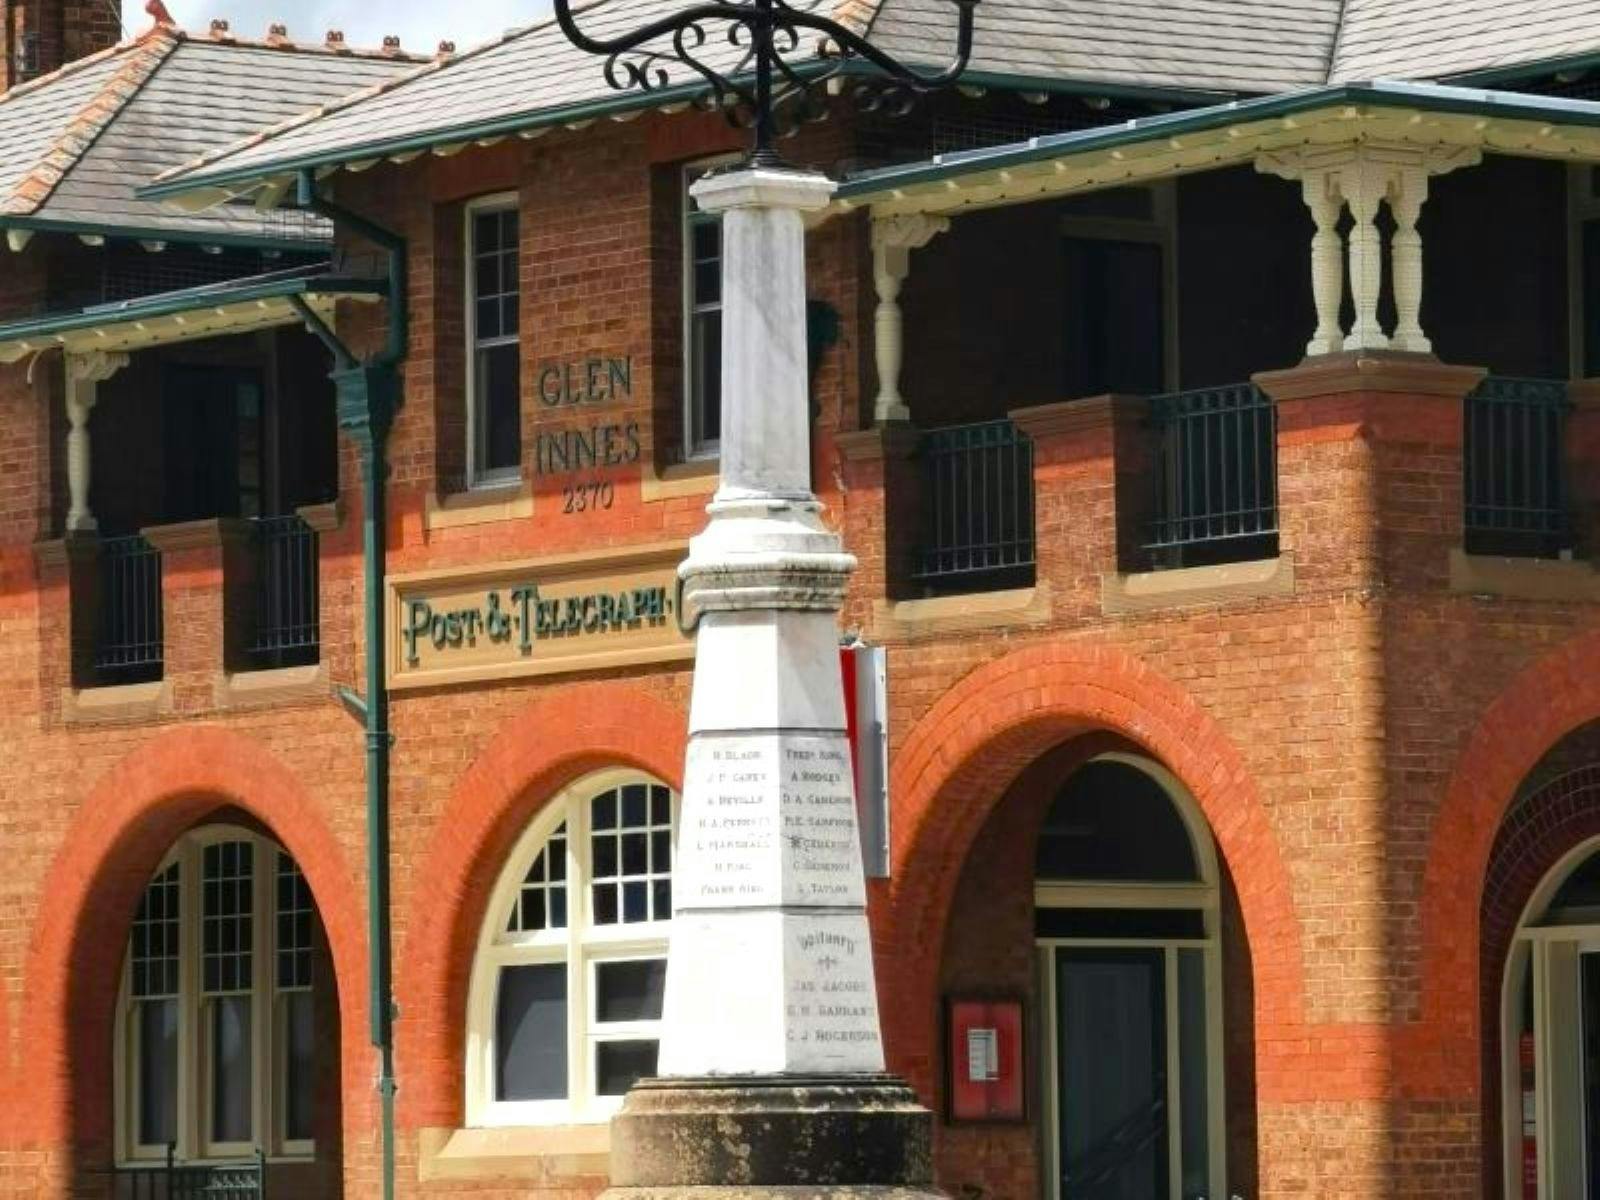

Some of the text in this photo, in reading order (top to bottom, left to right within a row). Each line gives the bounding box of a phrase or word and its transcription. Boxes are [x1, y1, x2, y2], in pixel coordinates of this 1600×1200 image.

[539, 356, 631, 406] GLEN
[536, 423, 640, 474] INNES
[563, 480, 614, 513] 2370
[487, 591, 511, 642] &
